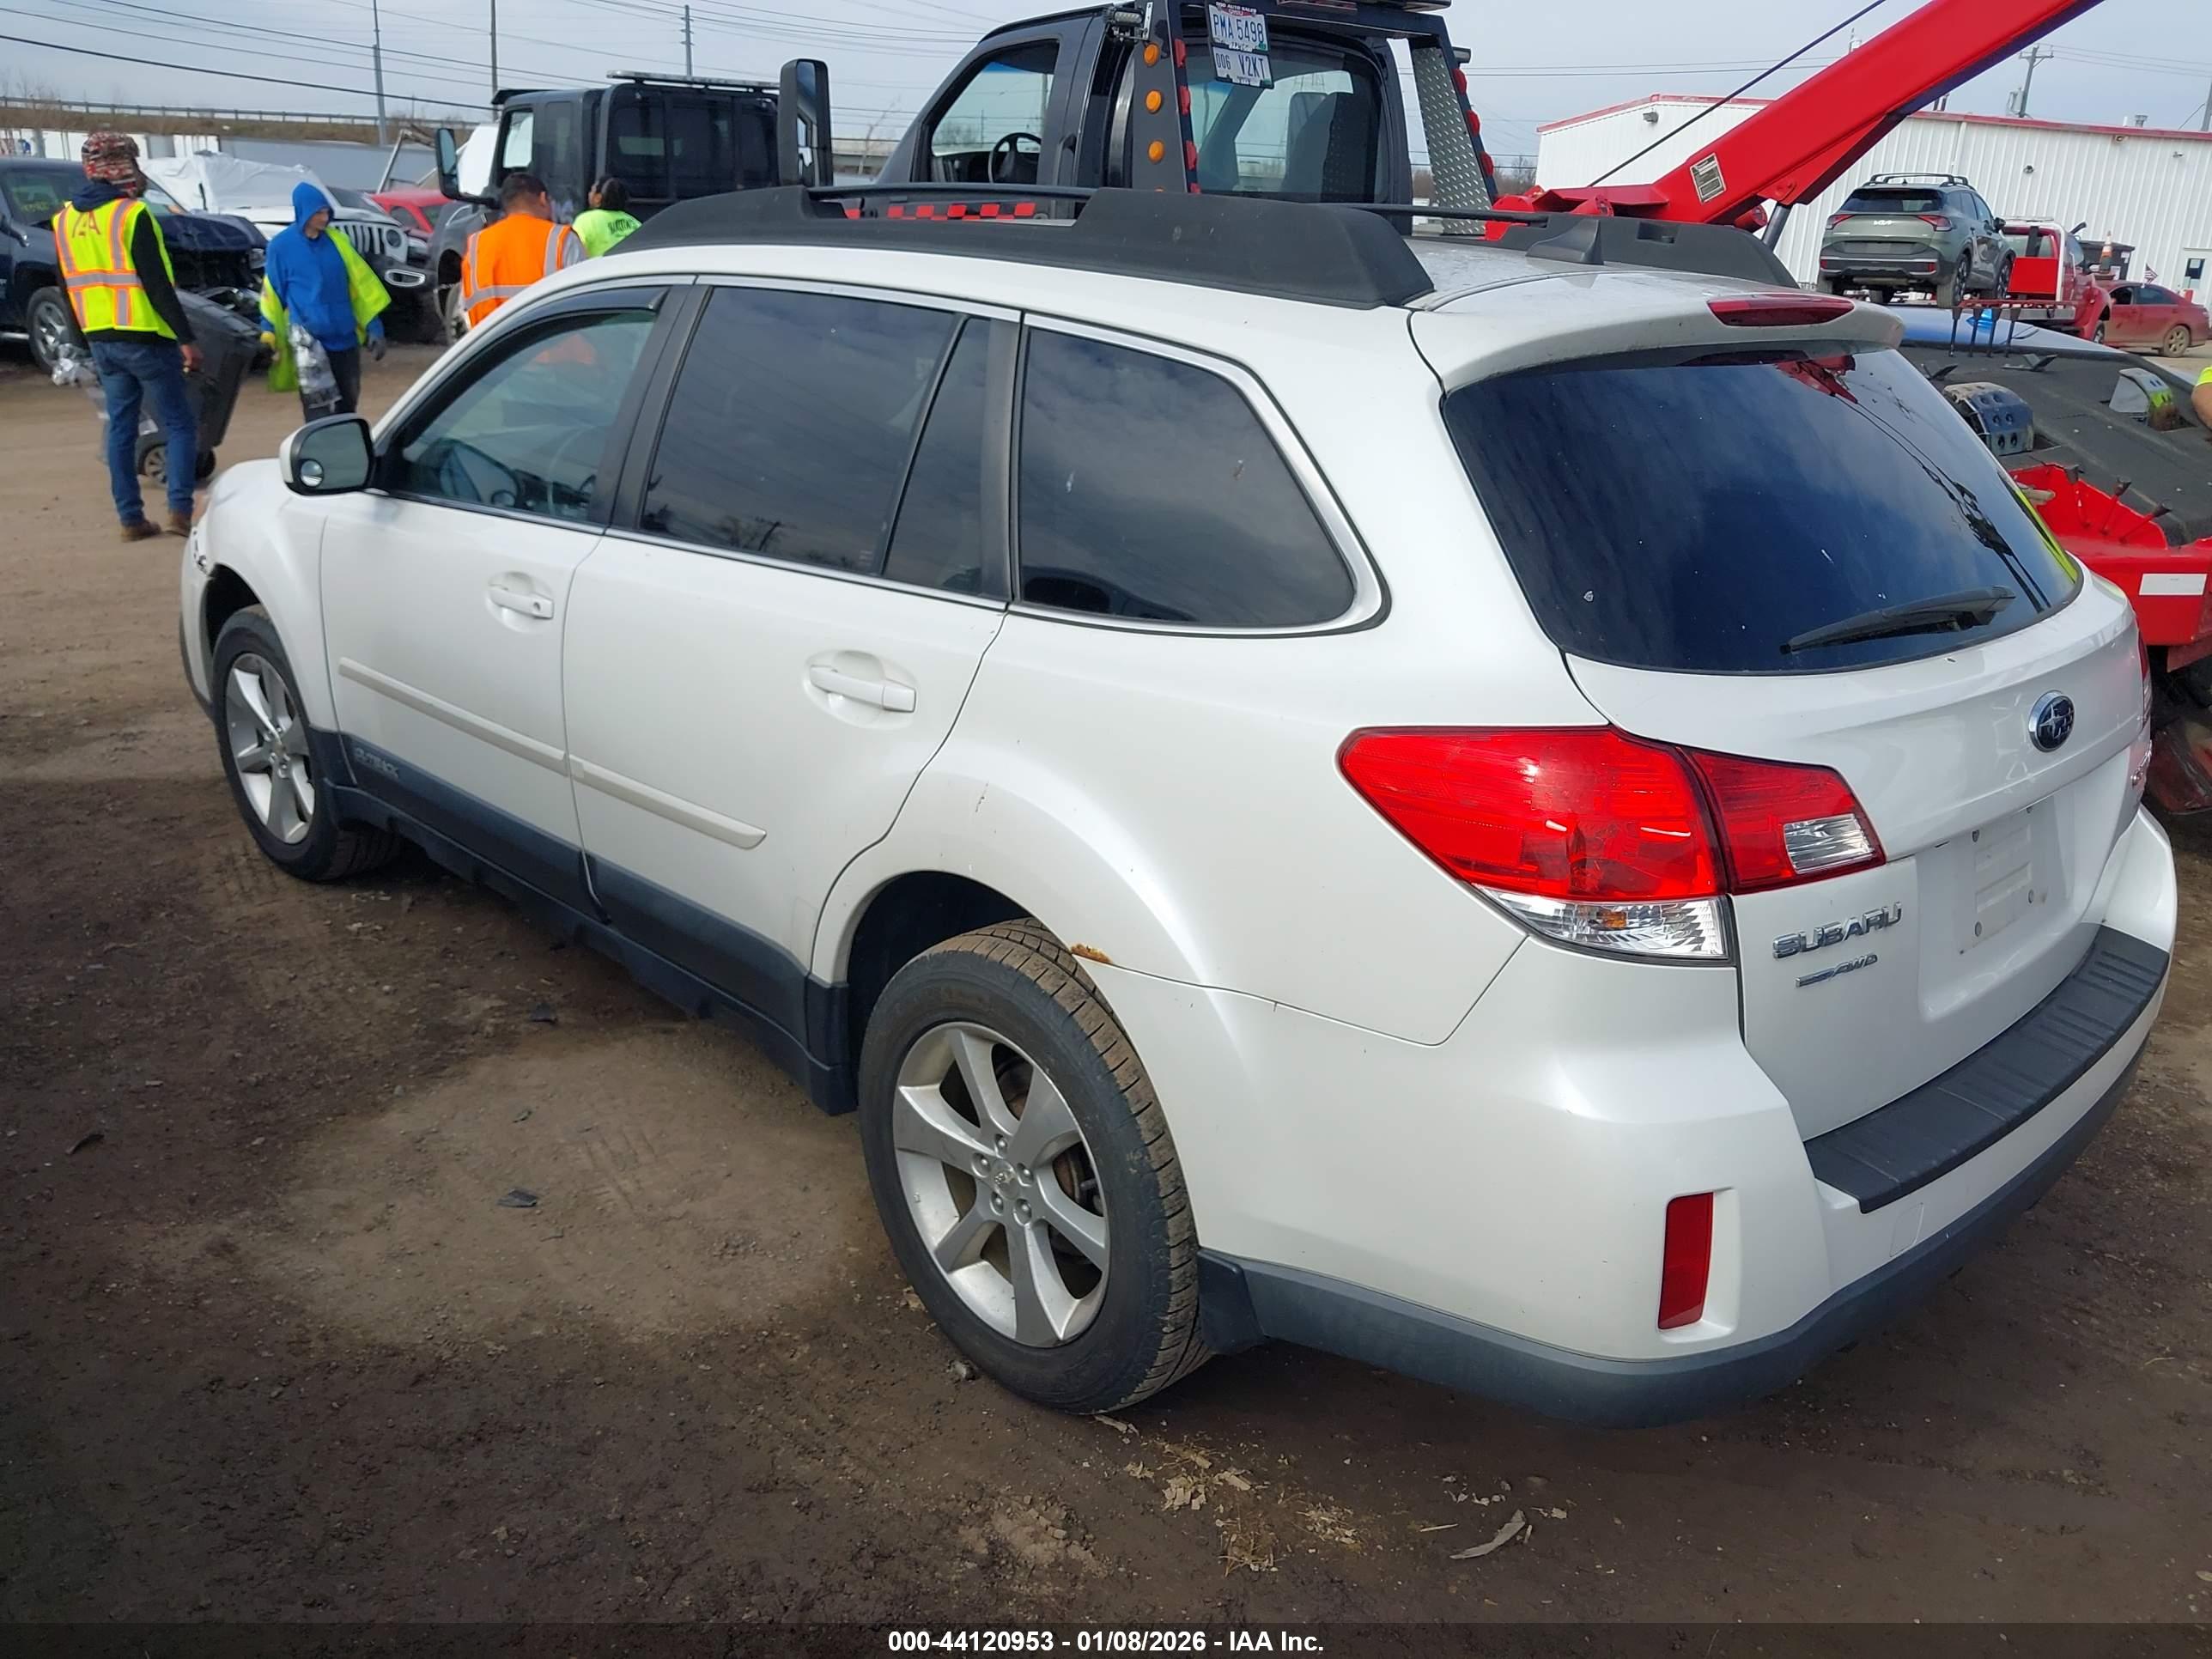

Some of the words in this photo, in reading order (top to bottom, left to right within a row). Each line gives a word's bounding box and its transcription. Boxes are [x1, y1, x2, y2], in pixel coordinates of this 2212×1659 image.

[1212, 14, 1234, 40] PMA
[1237, 18, 1264, 44] 5498
[1238, 54, 1266, 80] V2KT
[1772, 902, 1902, 959] SUBARU
